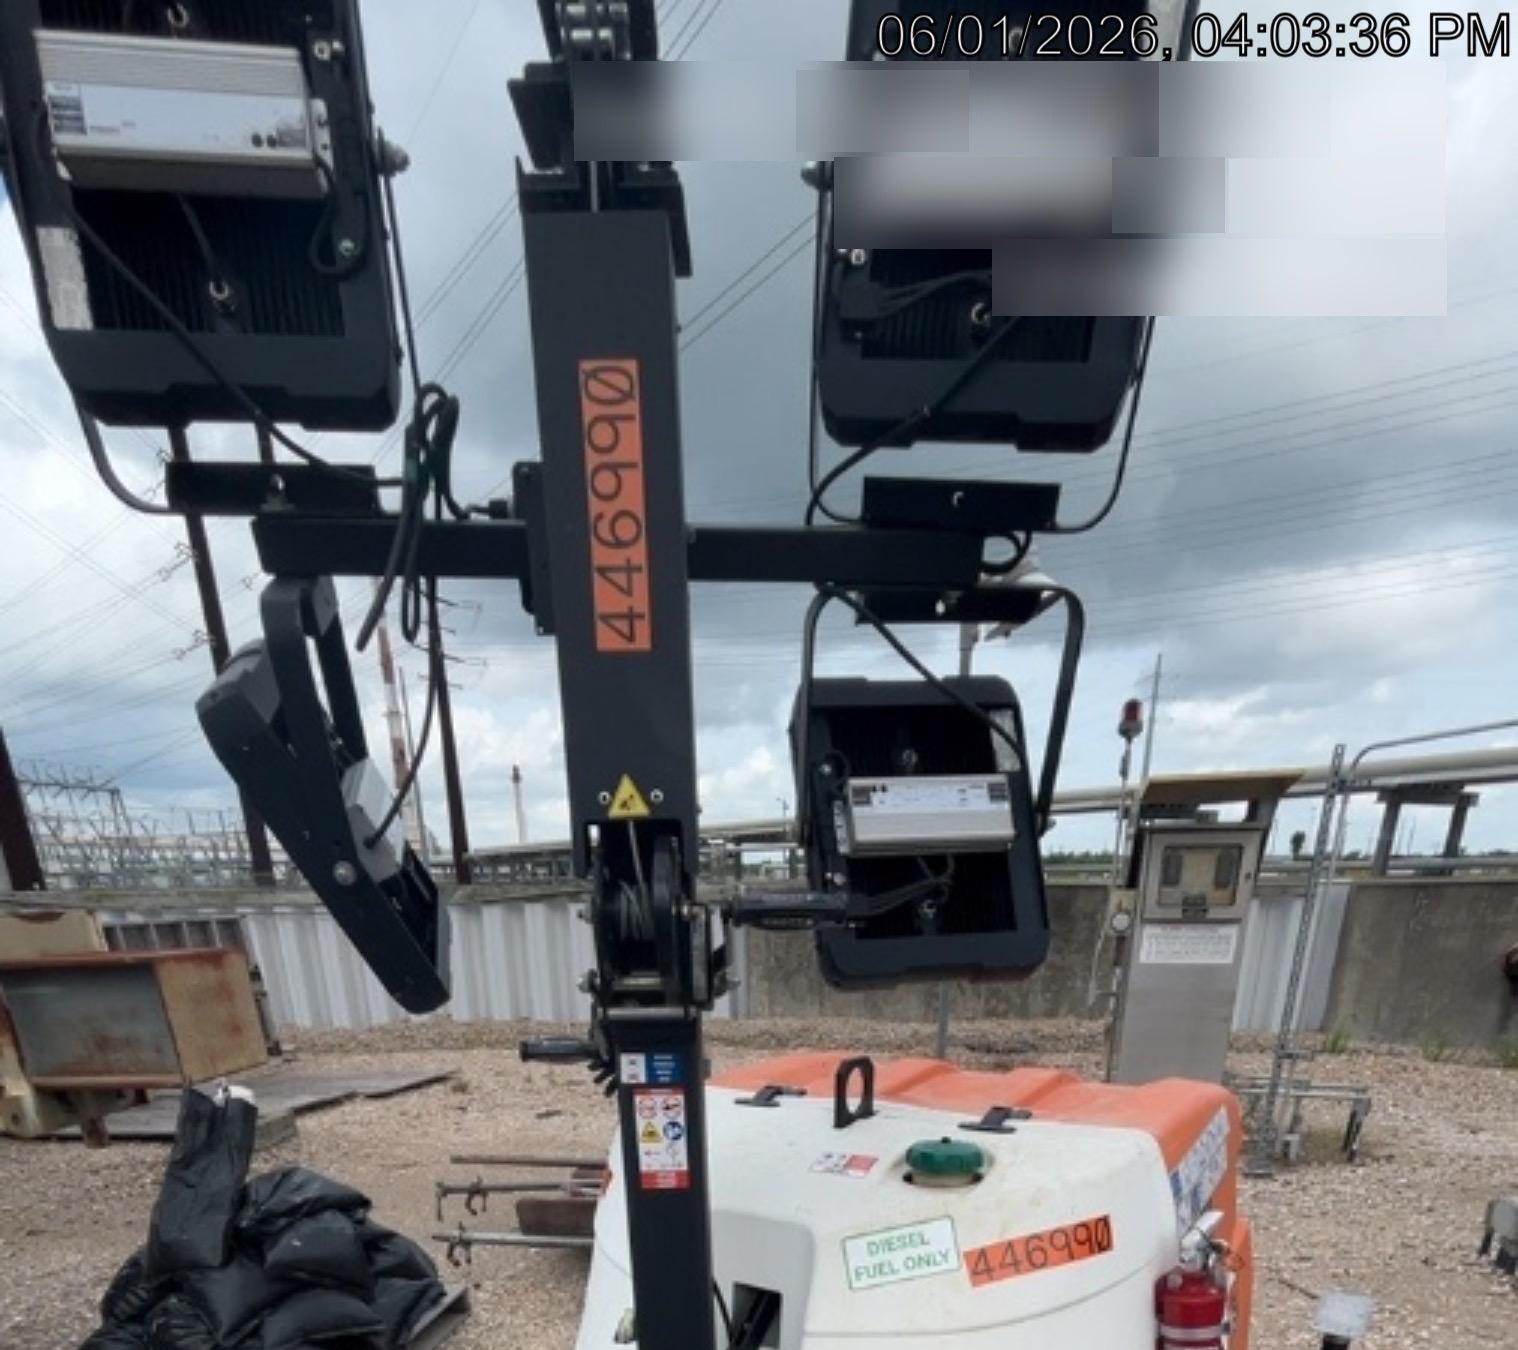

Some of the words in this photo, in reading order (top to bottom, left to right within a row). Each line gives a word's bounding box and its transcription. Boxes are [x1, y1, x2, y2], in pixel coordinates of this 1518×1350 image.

[583, 364, 646, 643] 446990
[854, 1258, 899, 1283] FUEL
[903, 1249, 953, 1276] ONLY
[866, 1230, 931, 1257] DIESEL
[971, 1215, 1112, 1281] 446990
